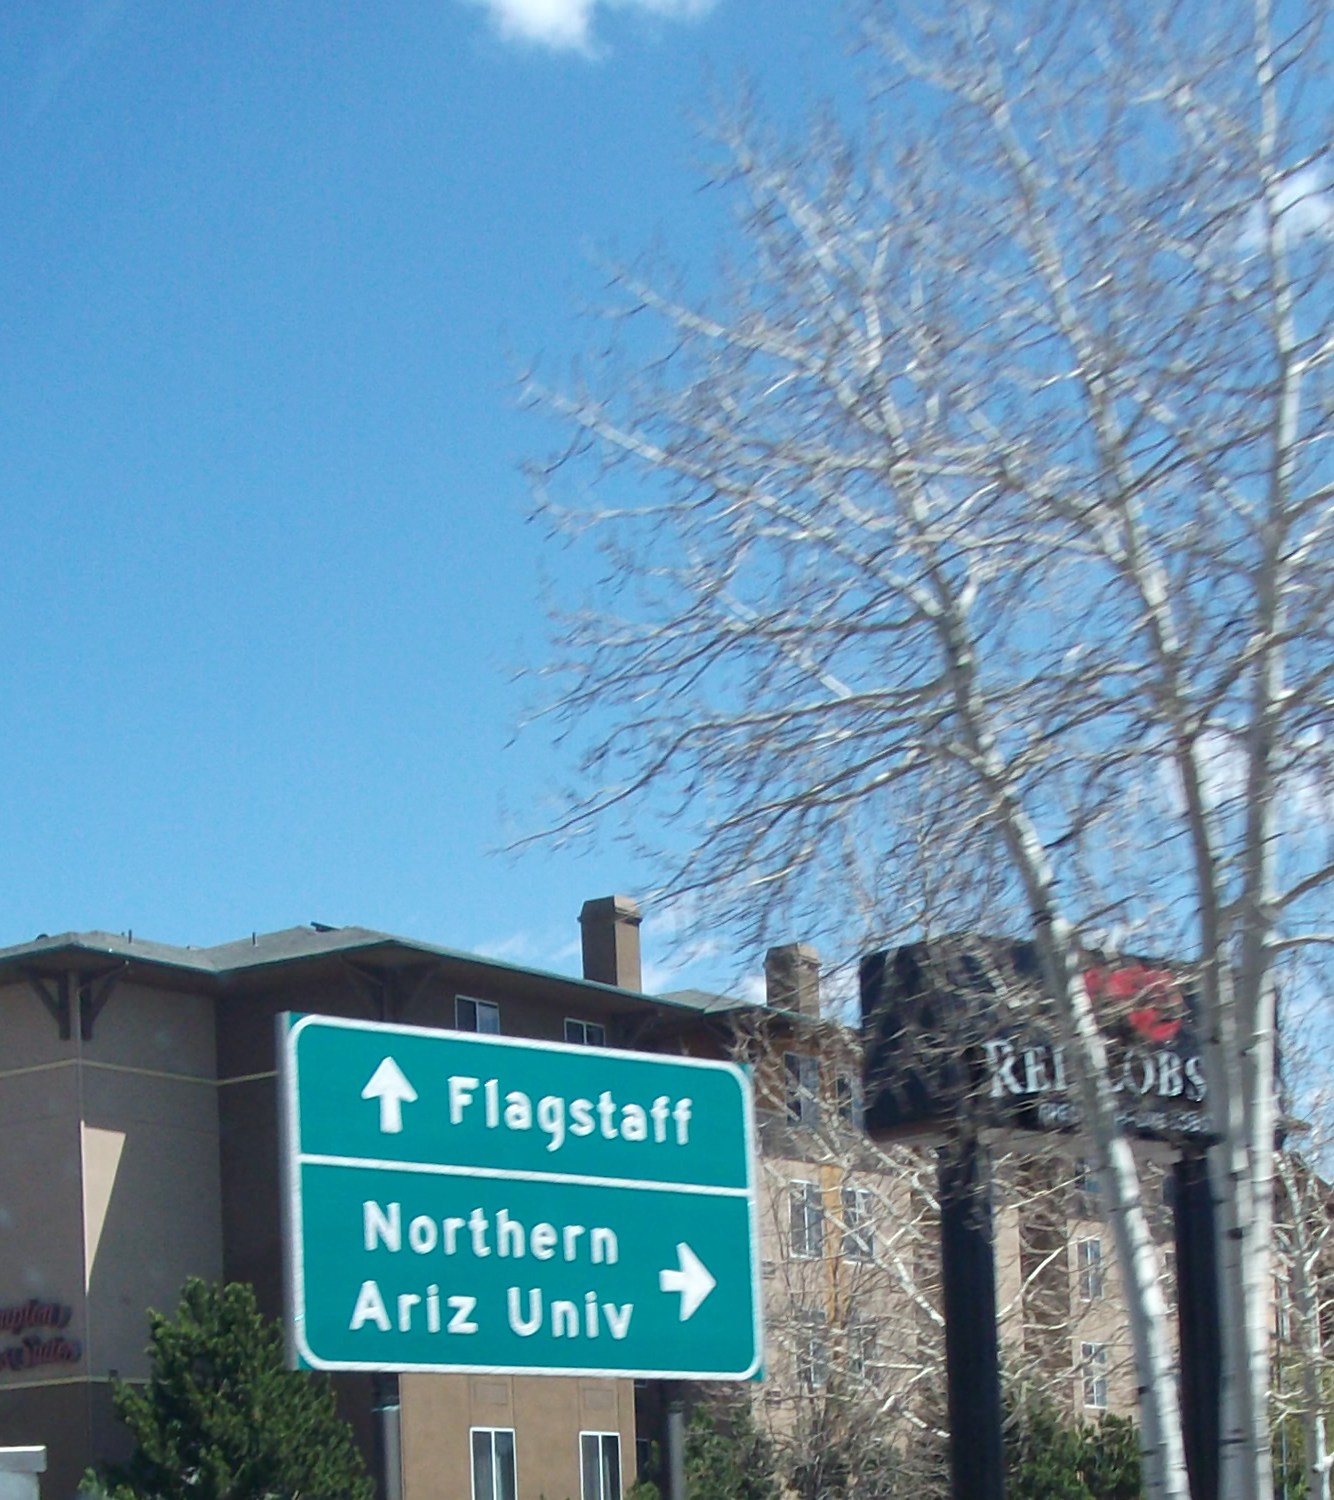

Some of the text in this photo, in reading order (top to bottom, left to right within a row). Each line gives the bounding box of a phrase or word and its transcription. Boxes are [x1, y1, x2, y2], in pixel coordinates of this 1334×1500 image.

[447, 1075, 693, 1152] Flagstaff
[362, 1200, 619, 1265] Northern
[349, 1280, 634, 1341] Ariz Univ
